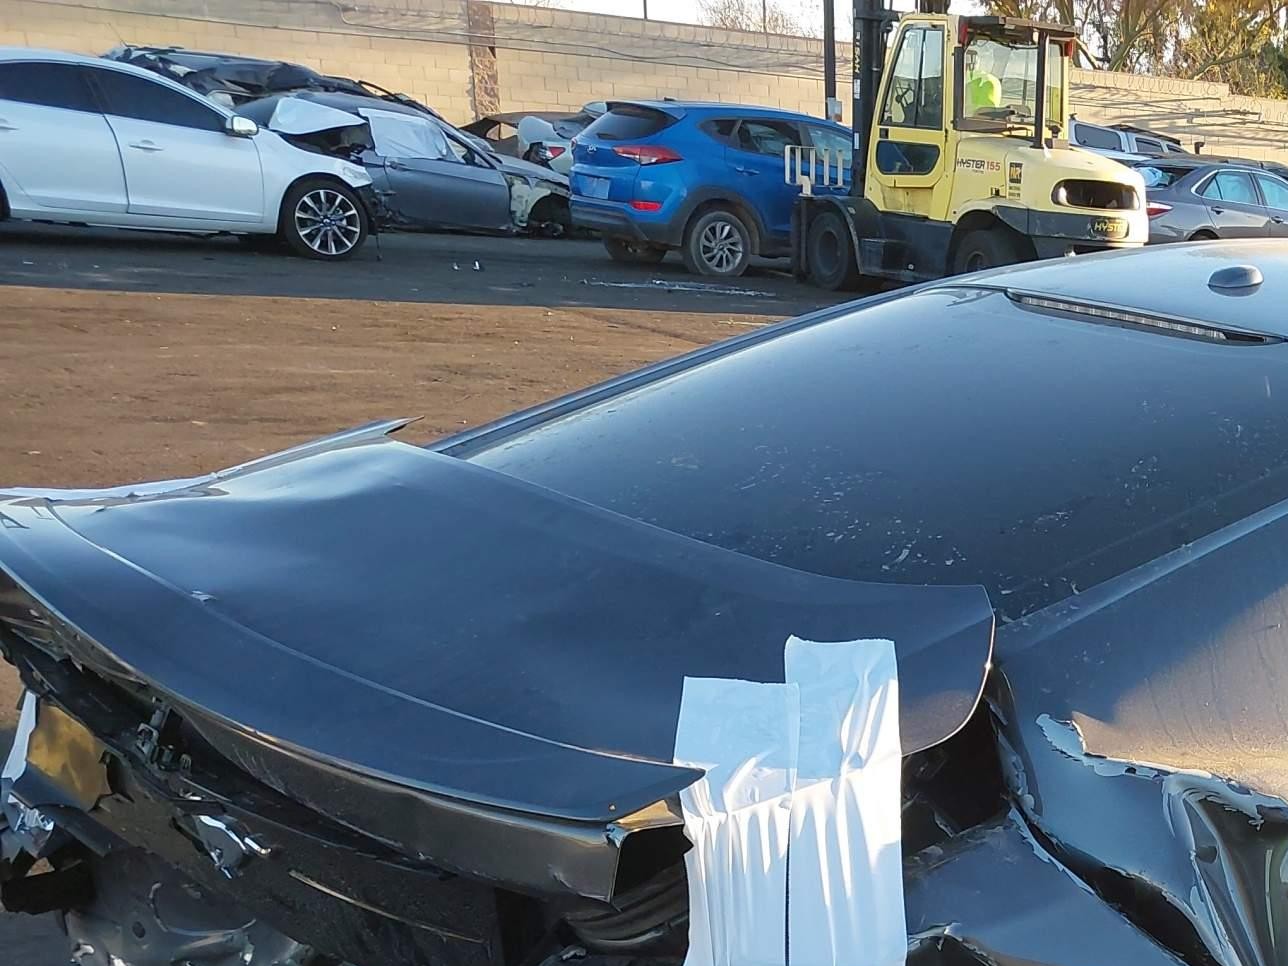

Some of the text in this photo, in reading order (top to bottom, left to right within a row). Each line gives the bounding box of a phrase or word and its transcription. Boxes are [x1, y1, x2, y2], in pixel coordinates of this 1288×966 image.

[956, 158, 1001, 171] HYSTER 155
[1093, 221, 1124, 232] HYST
